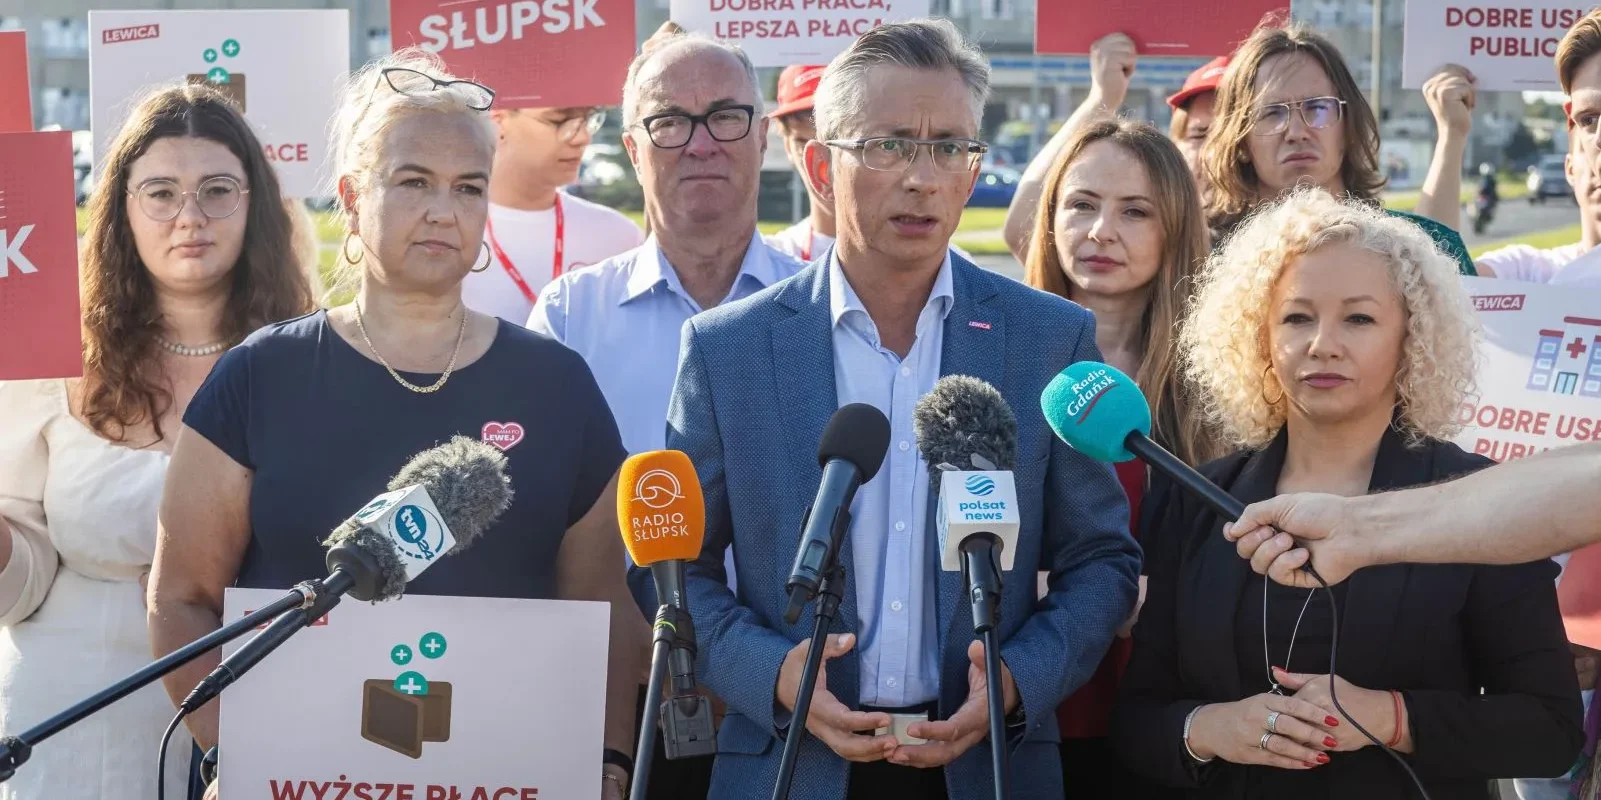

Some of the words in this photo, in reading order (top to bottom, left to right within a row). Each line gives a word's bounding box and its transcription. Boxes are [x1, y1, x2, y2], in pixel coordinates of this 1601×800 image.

[710, 0, 795, 12] DOBRA
[802, 0, 892, 11] PRACA,
[1446, 7, 1533, 27] DOBRE
[105, 26, 157, 41] LEWICA
[419, 0, 606, 53] SŁUPSK
[715, 20, 800, 38] LEPSZA
[1470, 37, 1559, 57] PUBLIC
[1474, 296, 1522, 309] EWICA
[1071, 369, 1106, 395] Radio
[1067, 374, 1116, 416] Gdańsk
[1460, 402, 1550, 435] DOBRE
[484, 433, 515, 441] LEWEJ
[959, 501, 1006, 511] polsat
[632, 512, 684, 529] RADIO
[965, 512, 1003, 520] news
[634, 525, 689, 542] SŁUPSK
[269, 774, 415, 800] WYŻSZE
